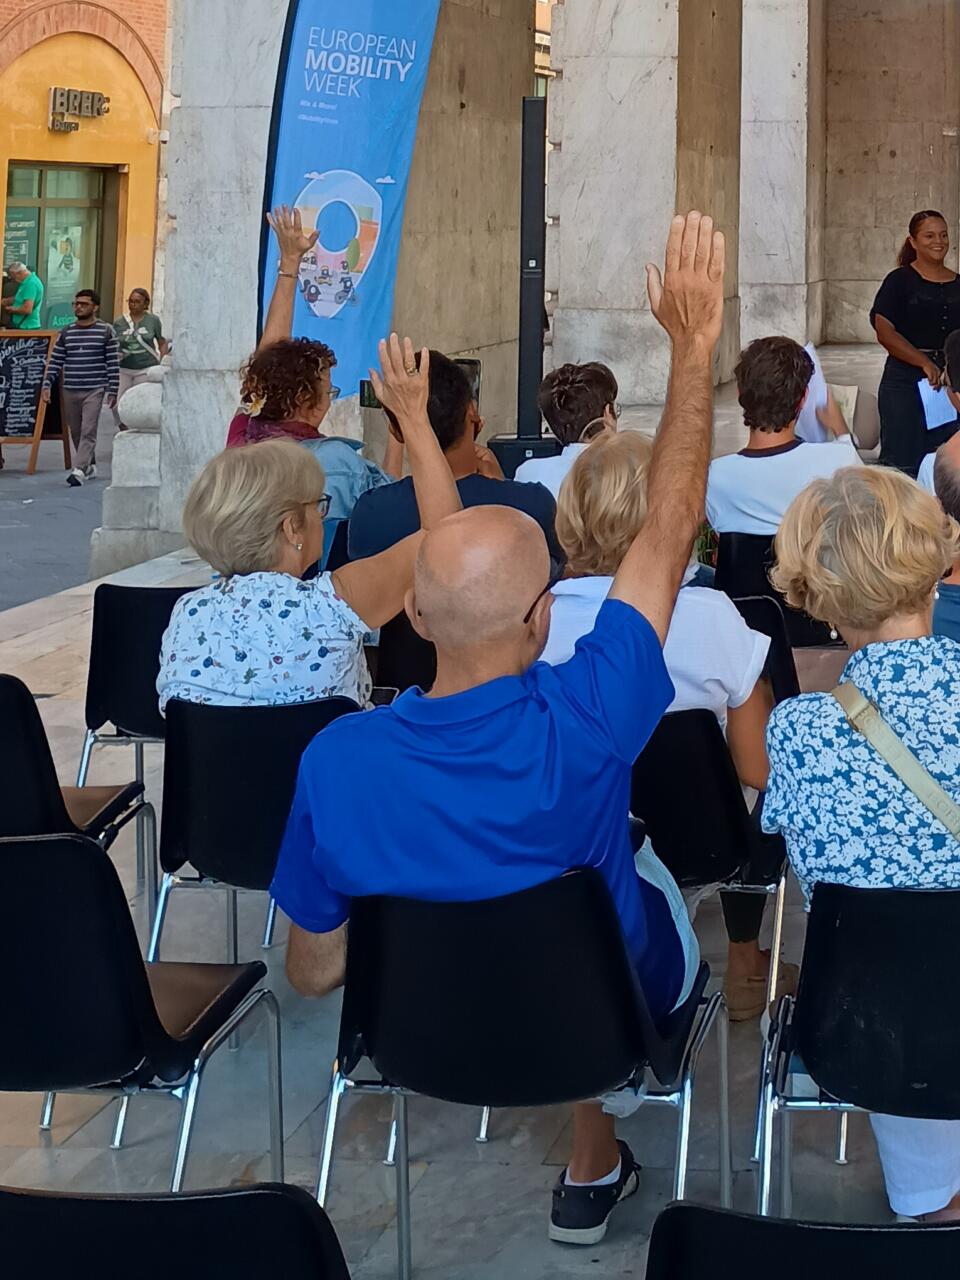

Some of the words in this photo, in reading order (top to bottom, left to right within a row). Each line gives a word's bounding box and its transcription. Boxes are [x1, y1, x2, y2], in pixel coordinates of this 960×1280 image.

[308, 26, 416, 60] EUROPEAN
[305, 48, 413, 82] MOBILITY
[304, 70, 362, 98] WEEK
